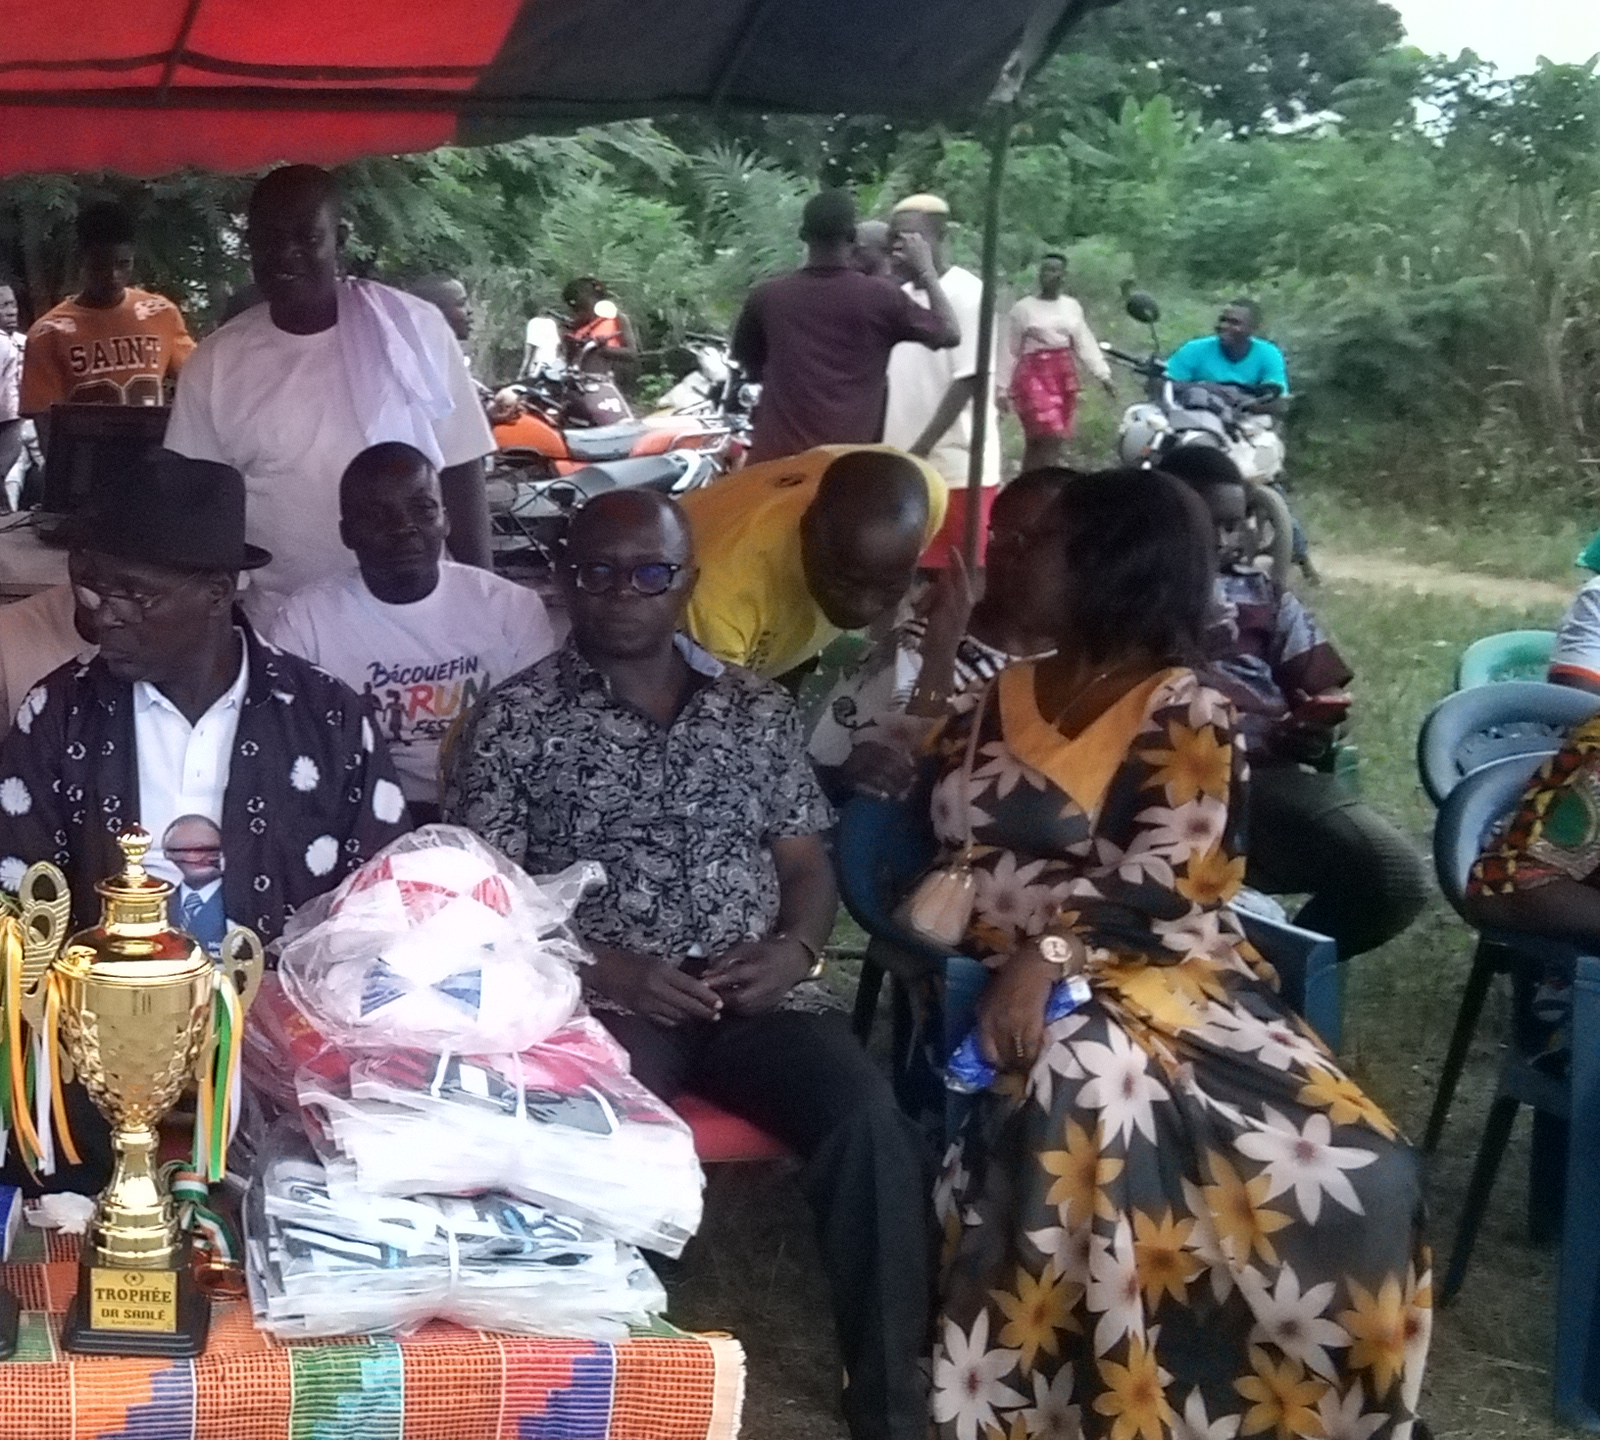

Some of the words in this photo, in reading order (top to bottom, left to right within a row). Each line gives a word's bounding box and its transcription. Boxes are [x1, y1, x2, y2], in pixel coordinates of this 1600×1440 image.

[69, 334, 162, 376] SAINT
[405, 672, 490, 720] RUN
[94, 1287, 172, 1303] TROPHÉE
[101, 1308, 119, 1318] DR
